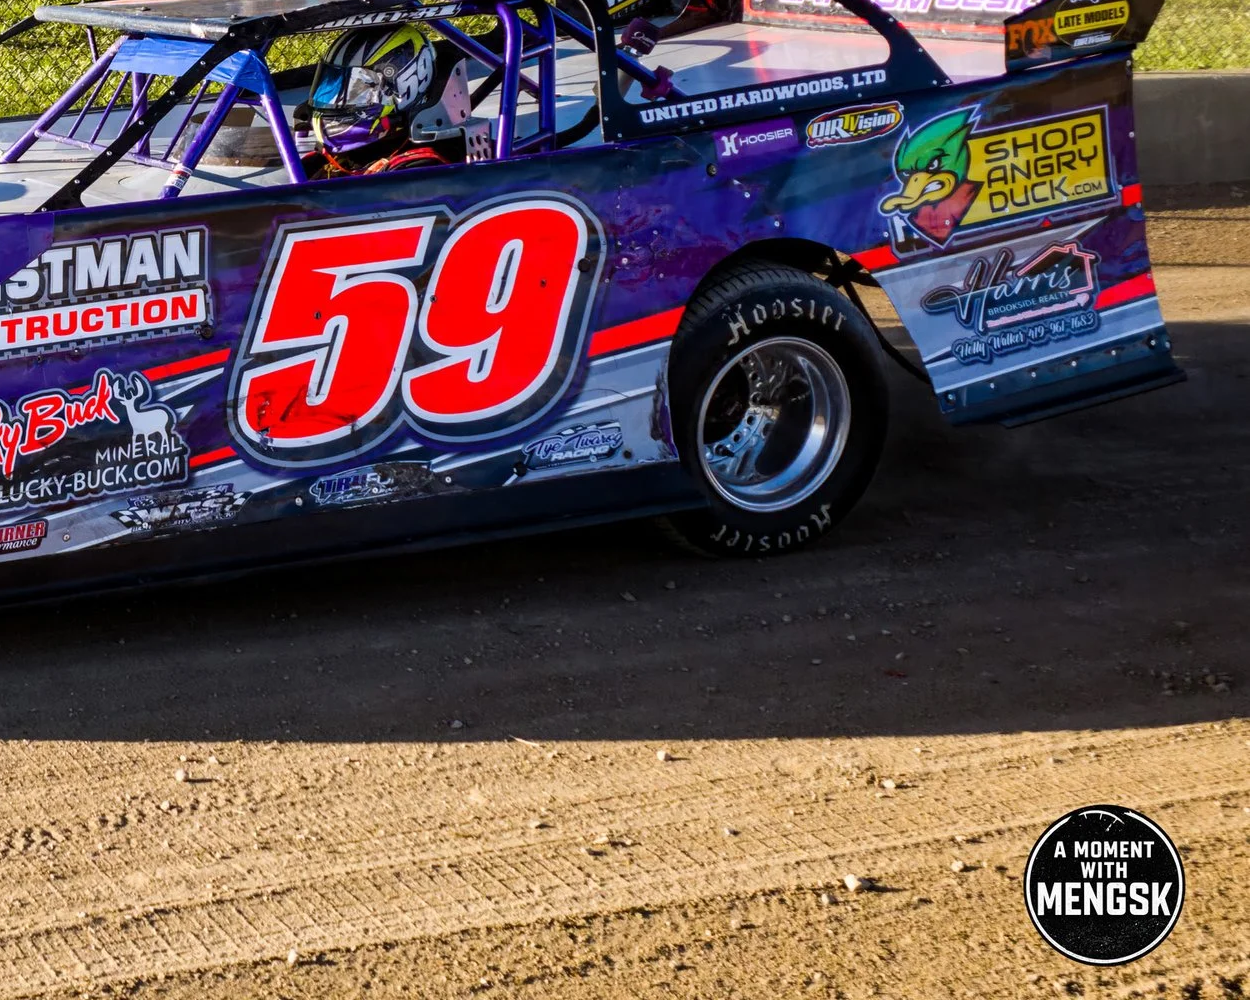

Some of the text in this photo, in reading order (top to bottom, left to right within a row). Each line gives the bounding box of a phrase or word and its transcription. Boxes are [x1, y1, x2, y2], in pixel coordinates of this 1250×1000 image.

[1007, 18, 1057, 50] FOX
[1058, 6, 1126, 29] LATE MODELS
[396, 46, 434, 110] 59
[640, 69, 887, 124] UNITED HARDWOODS, LTD
[739, 127, 794, 147] HOOSIER
[984, 121, 1096, 164] SHOP
[987, 145, 1098, 189] ANGRY
[926, 251, 1080, 331] Harris
[988, 298, 1036, 316] BROOKSIDE
[1038, 291, 1070, 304] REALTY
[242, 200, 589, 447] 59
[721, 297, 848, 346] Hoosier
[19, 374, 121, 455] Buck
[95, 434, 183, 465] MINERAL
[551, 445, 610, 462] RACING
